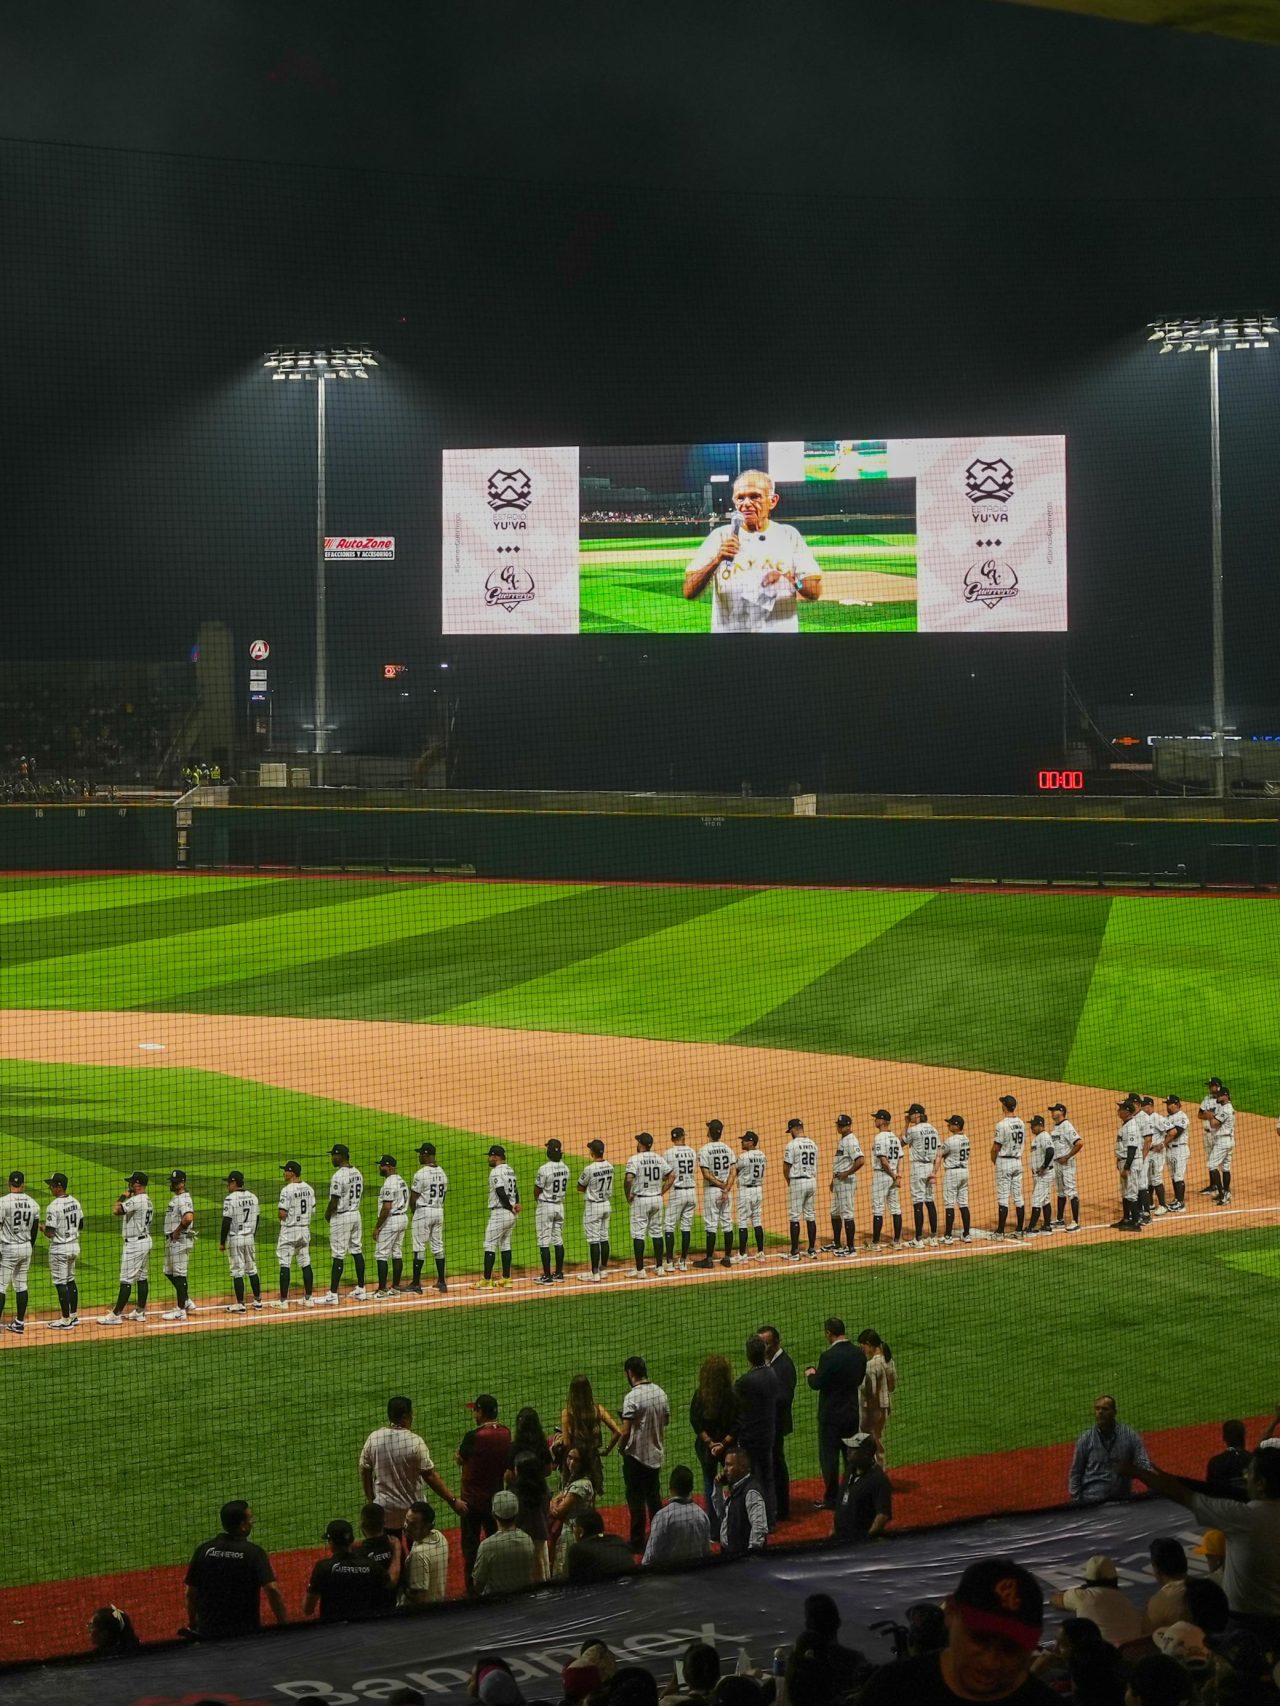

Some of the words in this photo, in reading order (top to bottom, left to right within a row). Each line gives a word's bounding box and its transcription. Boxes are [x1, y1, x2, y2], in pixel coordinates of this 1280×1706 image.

[971, 505, 1008, 513] ESTADIO
[493, 513, 526, 521] ESTADIO
[972, 513, 1009, 523] YU'VA
[493, 522, 527, 530] YU'VA
[336, 539, 392, 548] AutoZone
[1039, 771, 1083, 788] 00:00
[713, 1156, 729, 1171] 62
[801, 1152, 815, 1166] 26
[644, 1167, 660, 1182] 40
[678, 1160, 694, 1174] 52
[430, 1183, 445, 1198] 58
[553, 1178, 567, 1193] 89
[598, 1176, 612, 1192] 77
[301, 1199, 308, 1214] 8
[14, 1210, 32, 1227] 24
[66, 1212, 77, 1230] 14
[242, 1208, 250, 1224] 7
